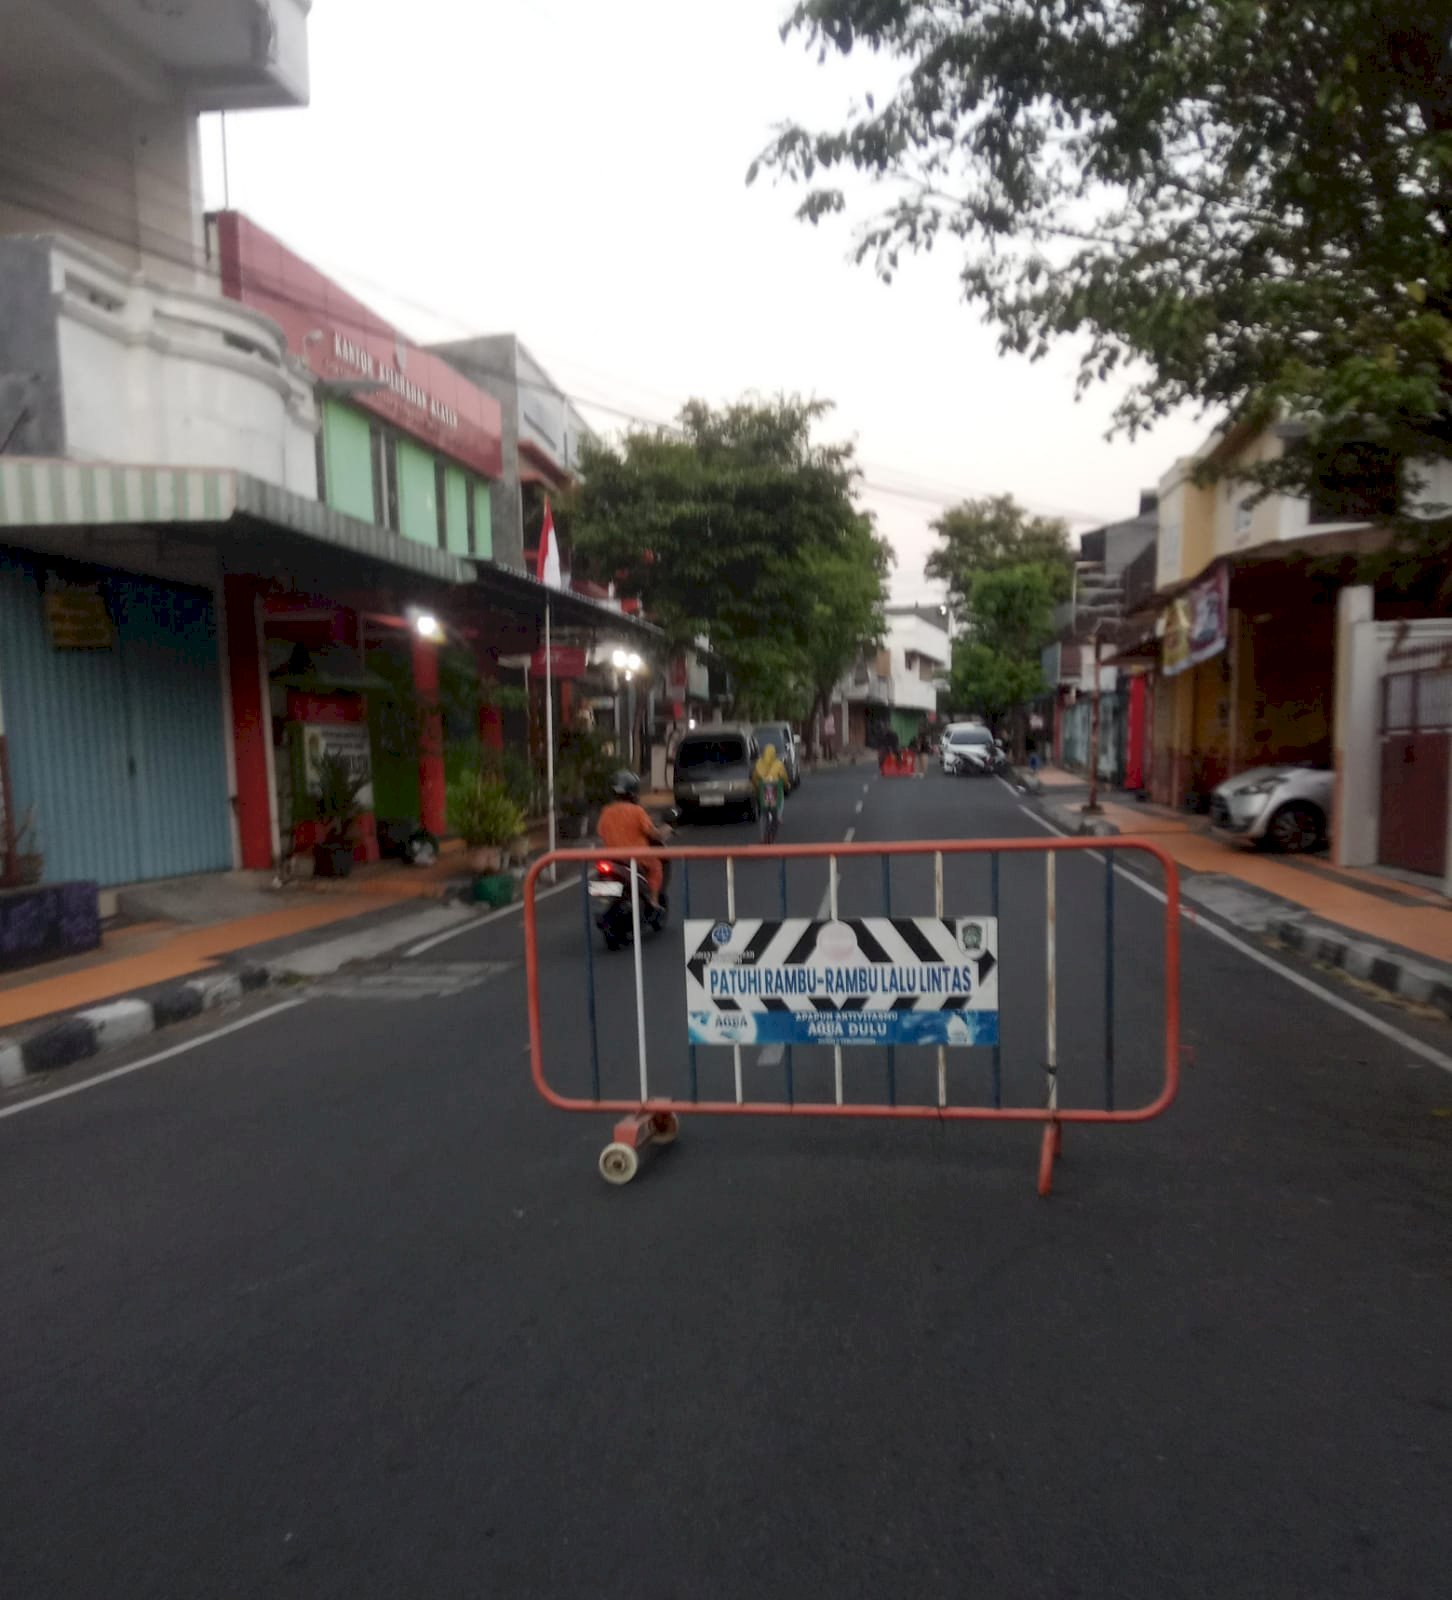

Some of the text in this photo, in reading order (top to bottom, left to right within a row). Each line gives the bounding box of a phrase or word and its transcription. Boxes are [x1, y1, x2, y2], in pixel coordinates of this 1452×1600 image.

[335, 331, 374, 378] KANTOR
[710, 966, 971, 995] PATUHI RAMBU-RAMBU LALU LINTAS
[715, 1014, 748, 1029] AQUA
[808, 1022, 887, 1037] AQUA DULU
